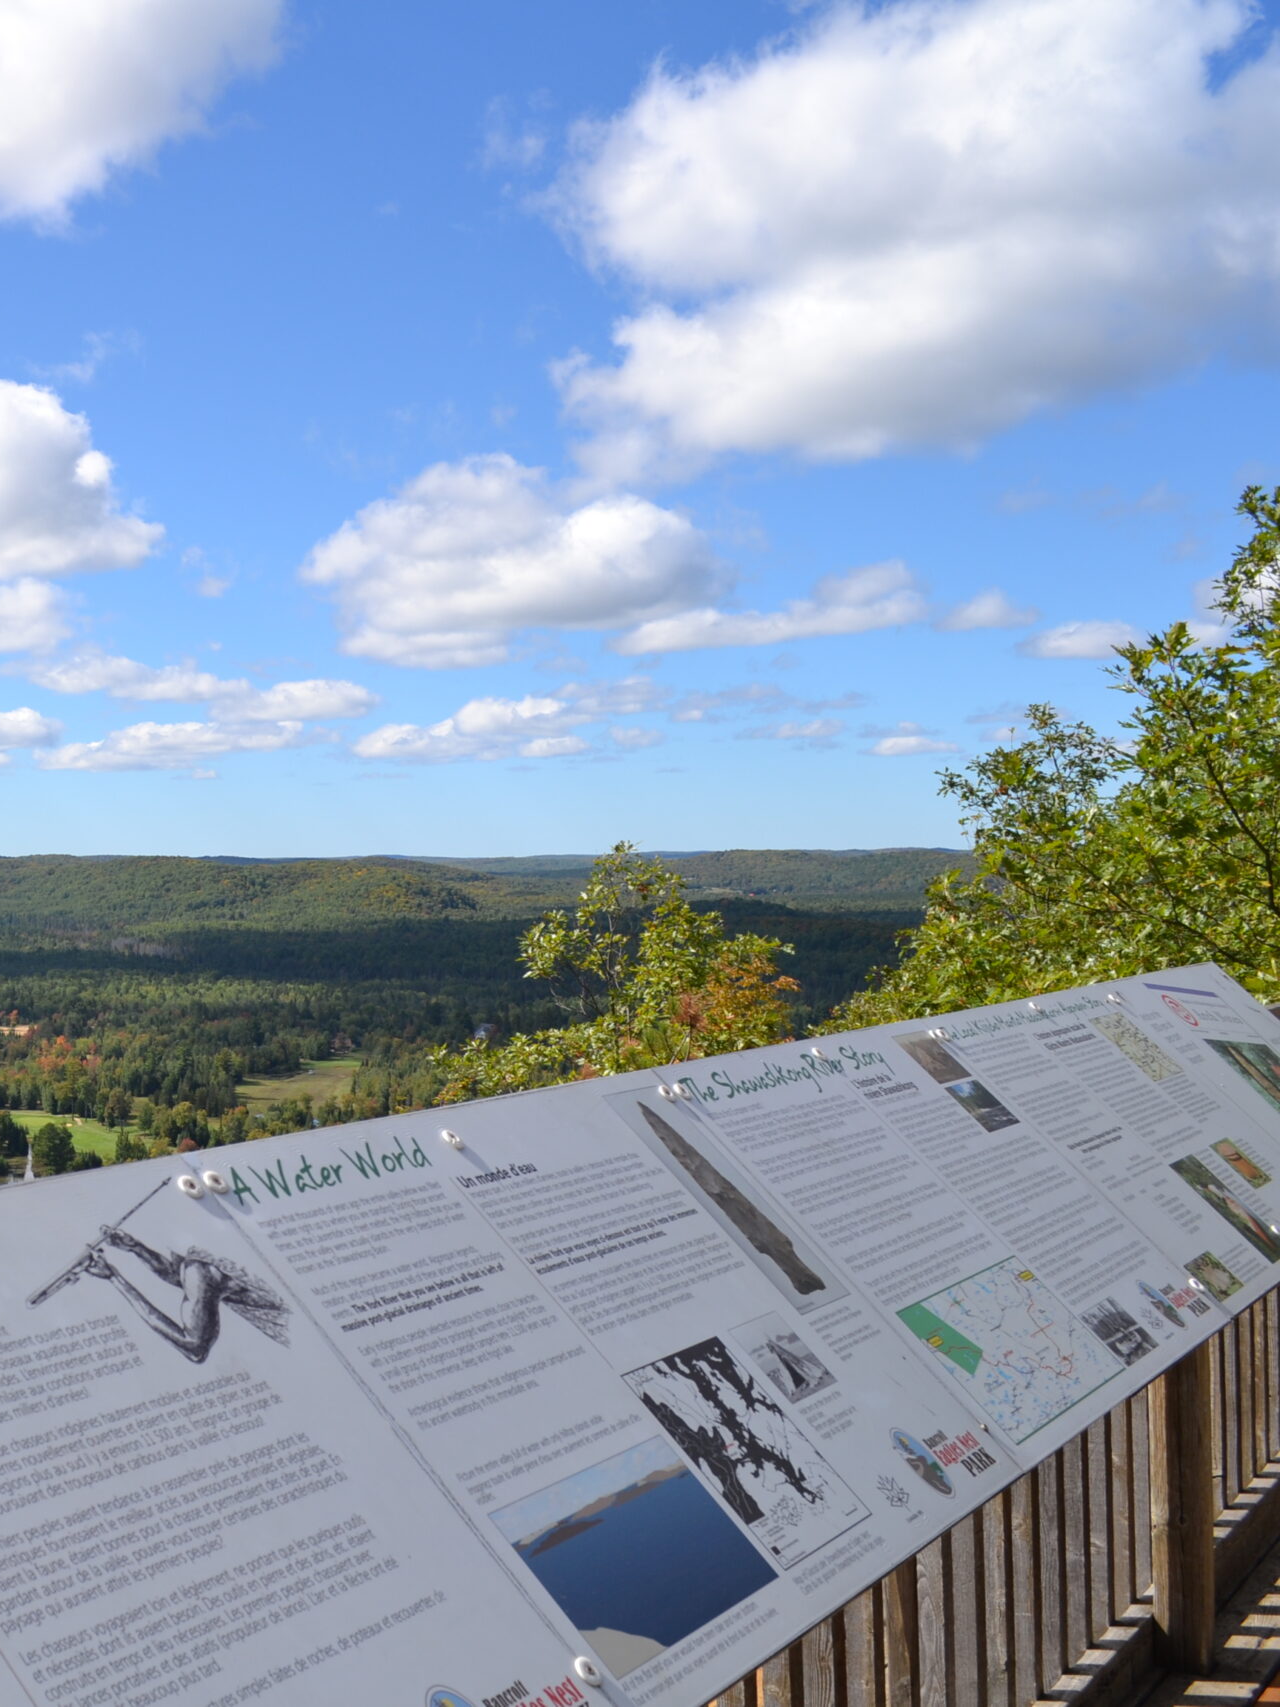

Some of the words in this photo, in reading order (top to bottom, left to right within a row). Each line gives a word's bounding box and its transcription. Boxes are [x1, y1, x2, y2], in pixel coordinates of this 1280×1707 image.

[678, 1077, 720, 1104] The
[800, 1052, 845, 1077] River
[839, 1045, 896, 1076] Story
[229, 1166, 261, 1207] A
[247, 1154, 343, 1200] Water
[340, 1136, 433, 1180] World
[456, 1173, 476, 1189] Un
[475, 1166, 511, 1185] monde
[509, 1161, 538, 1179] d'eau
[340, 1319, 369, 1332] massive
[367, 1306, 406, 1326] post-glacial
[405, 1299, 437, 1314] drainages
[434, 1294, 444, 1304] of
[442, 1289, 466, 1302] ancient
[351, 1304, 368, 1313] The
[364, 1299, 383, 1310] York
[379, 1295, 399, 1305] River
[398, 1290, 414, 1301] that
[412, 1288, 427, 1299] you
[424, 1284, 437, 1293] see
[433, 1279, 455, 1290] below
[460, 1272, 470, 1283] all
[466, 1270, 482, 1280] that
[486, 1265, 498, 1274] left
[960, 1446, 997, 1477] PARK
[543, 1676, 584, 1706] Nest
